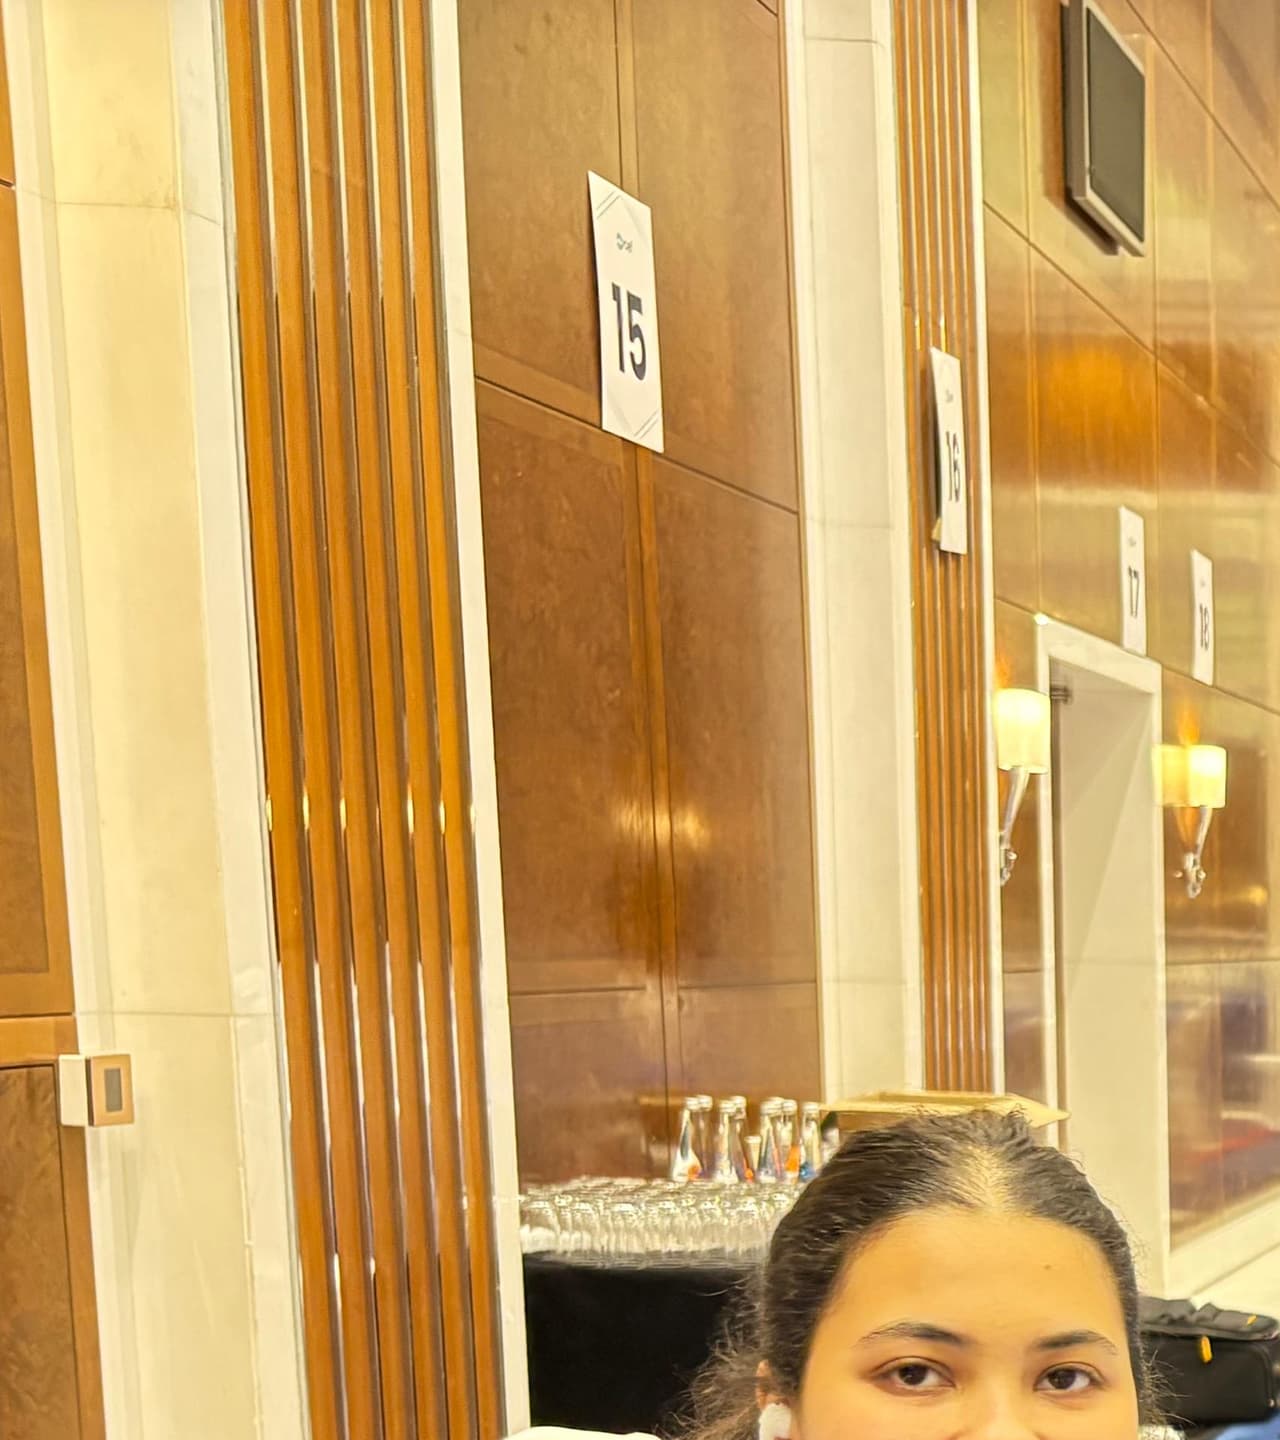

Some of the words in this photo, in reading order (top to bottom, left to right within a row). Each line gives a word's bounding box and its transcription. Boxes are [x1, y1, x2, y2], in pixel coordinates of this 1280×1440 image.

[611, 282, 647, 381] 15
[945, 430, 961, 503] 16
[1127, 565, 1140, 619] 17
